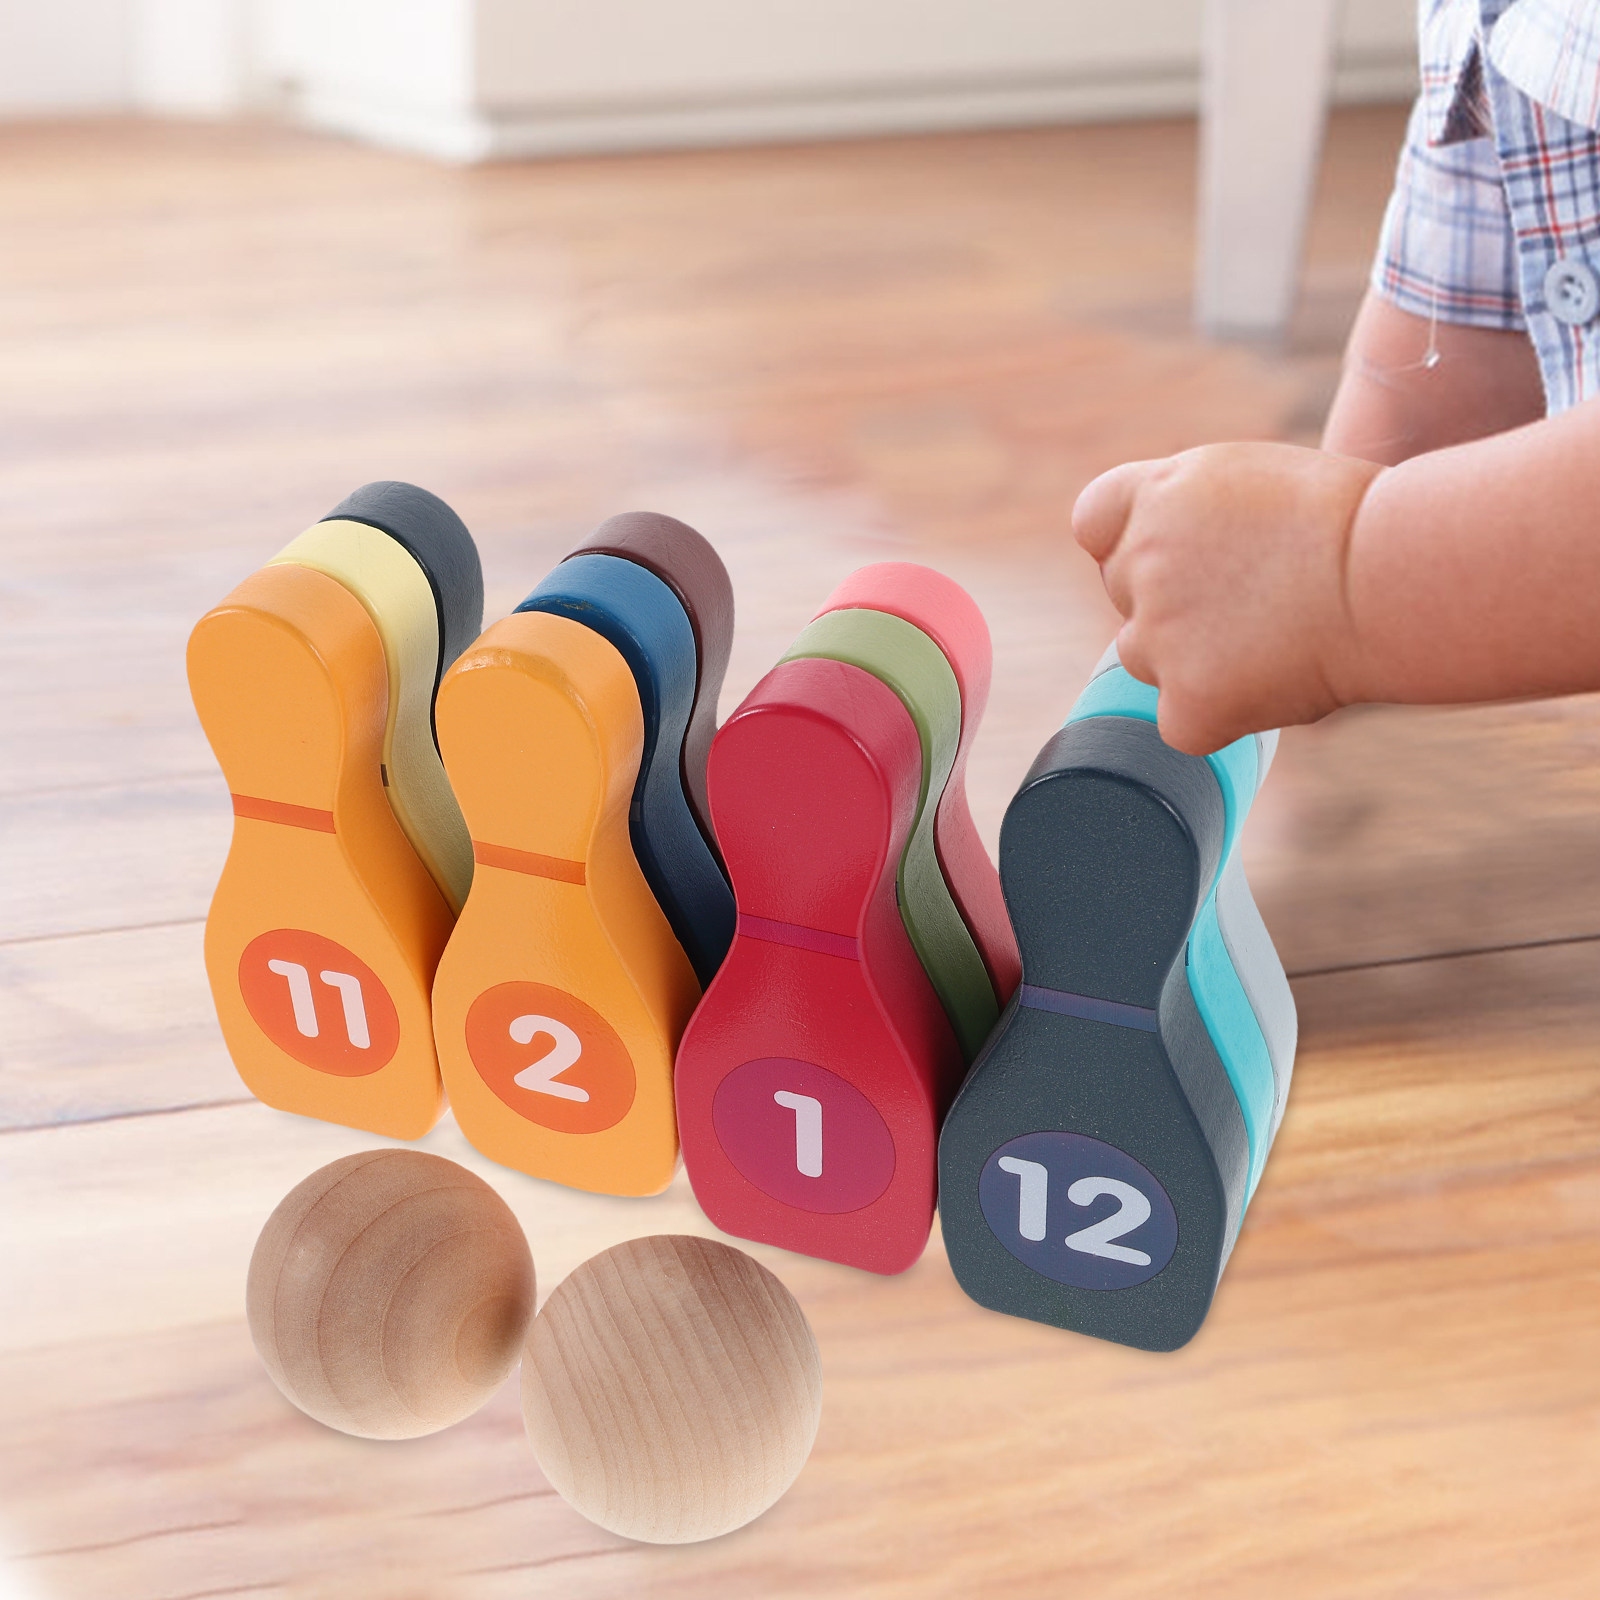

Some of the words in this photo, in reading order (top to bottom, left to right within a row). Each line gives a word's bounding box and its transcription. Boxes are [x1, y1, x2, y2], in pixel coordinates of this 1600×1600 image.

[267, 958, 371, 1050] 11
[508, 1014, 590, 1103] 2
[773, 1090, 823, 1178] 1
[998, 1156, 1152, 1266] 12
